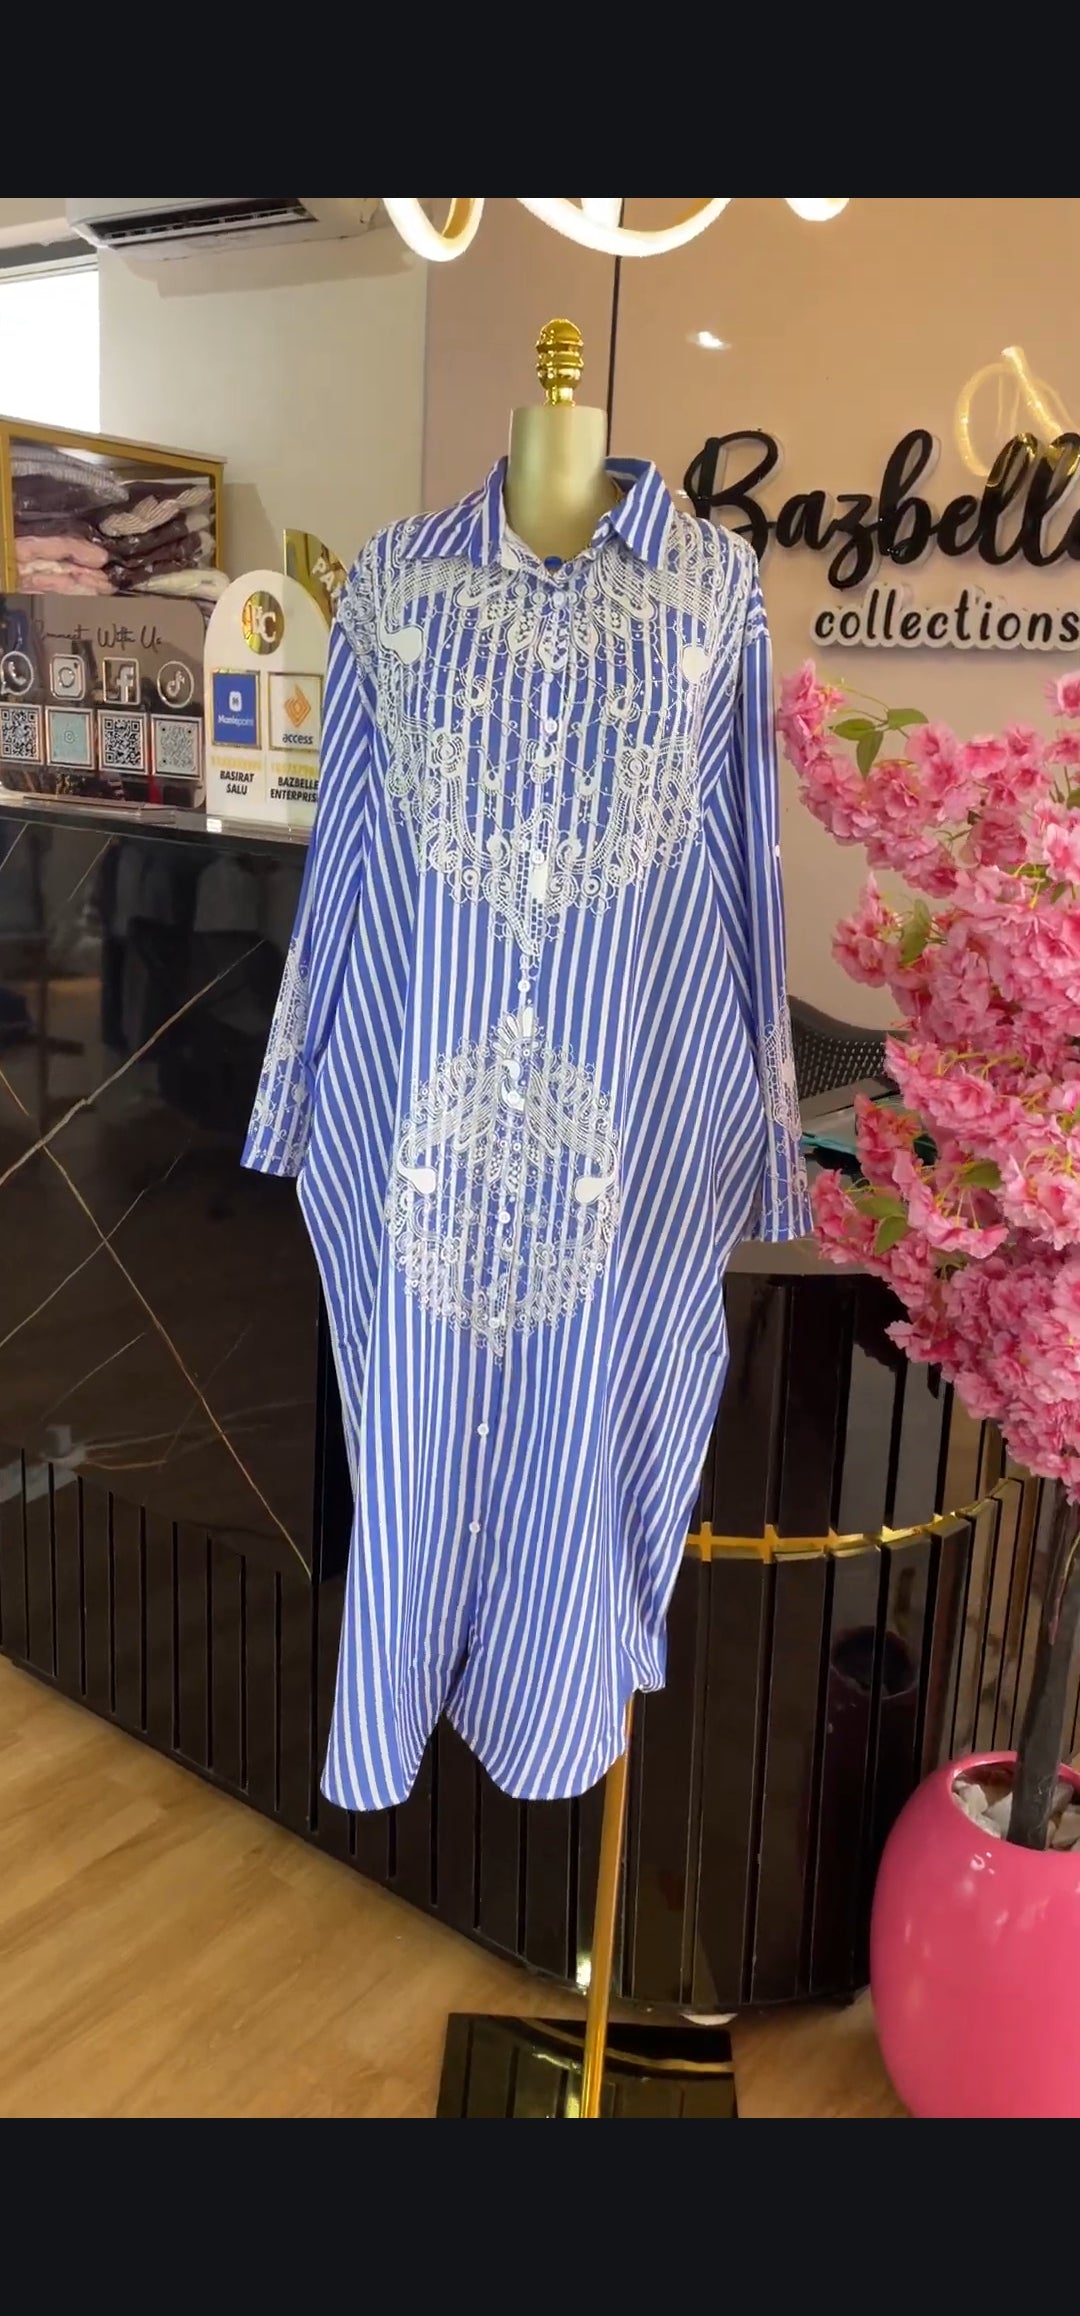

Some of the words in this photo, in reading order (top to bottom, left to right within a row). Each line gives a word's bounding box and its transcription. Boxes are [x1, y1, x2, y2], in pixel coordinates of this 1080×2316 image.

[683, 430, 1080, 588] Bazbell
[814, 588, 1080, 643] collections
[97, 623, 136, 651] With
[141, 625, 162, 653] Us
[282, 733, 314, 745] access
[220, 770, 255, 783] BASIRAT
[278, 776, 319, 790] BAZBELLE
[226, 783, 248, 795] SALU
[270, 788, 318, 803] ENTERPRIS
